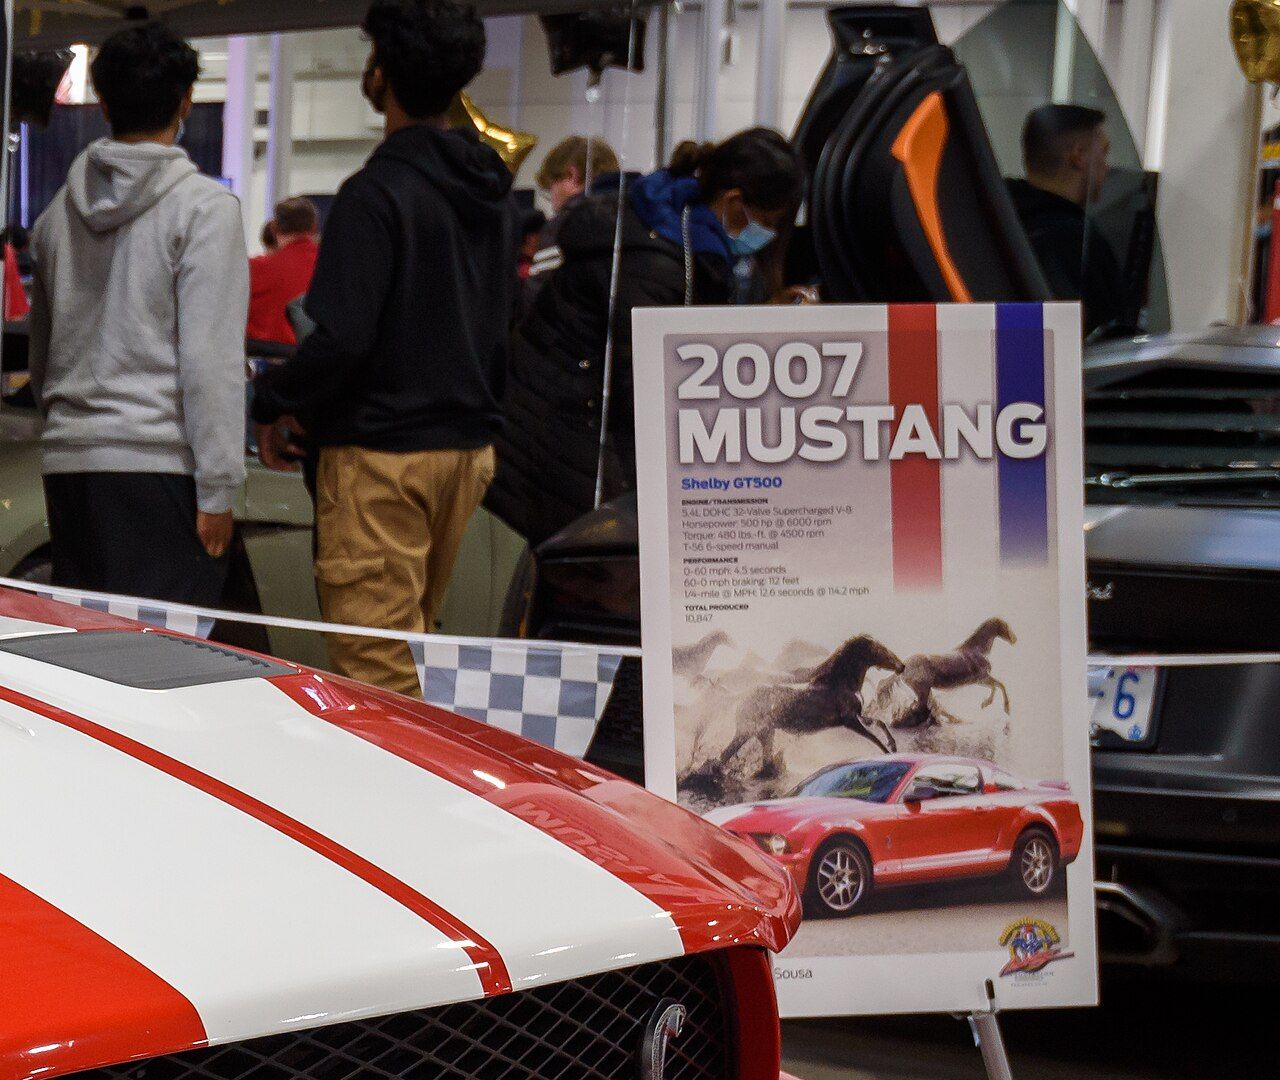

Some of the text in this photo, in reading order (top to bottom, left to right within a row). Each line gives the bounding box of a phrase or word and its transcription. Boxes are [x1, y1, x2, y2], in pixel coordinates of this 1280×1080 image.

[676, 341, 863, 400] 2007
[677, 402, 1048, 465] MUSTANG
[681, 476, 783, 491] Shelby GT500
[703, 507, 731, 517] DOHC
[772, 505, 834, 516] Supercharged
[740, 519, 759, 527] 500
[760, 519, 773, 528] hp
[786, 517, 812, 527] 6000
[813, 518, 832, 527] rpm
[806, 530, 825, 539] rpm
[706, 541, 743, 552] 6-speed
[745, 541, 779, 550] manual
[683, 567, 707, 576] 0-60
[749, 565, 787, 575] seconds
[683, 578, 708, 587] 60-0
[709, 578, 730, 588] mph
[782, 576, 799, 585] feet
[777, 587, 814, 597] seconds
[849, 586, 870, 597] mph
[774, 967, 813, 979] Sousa
